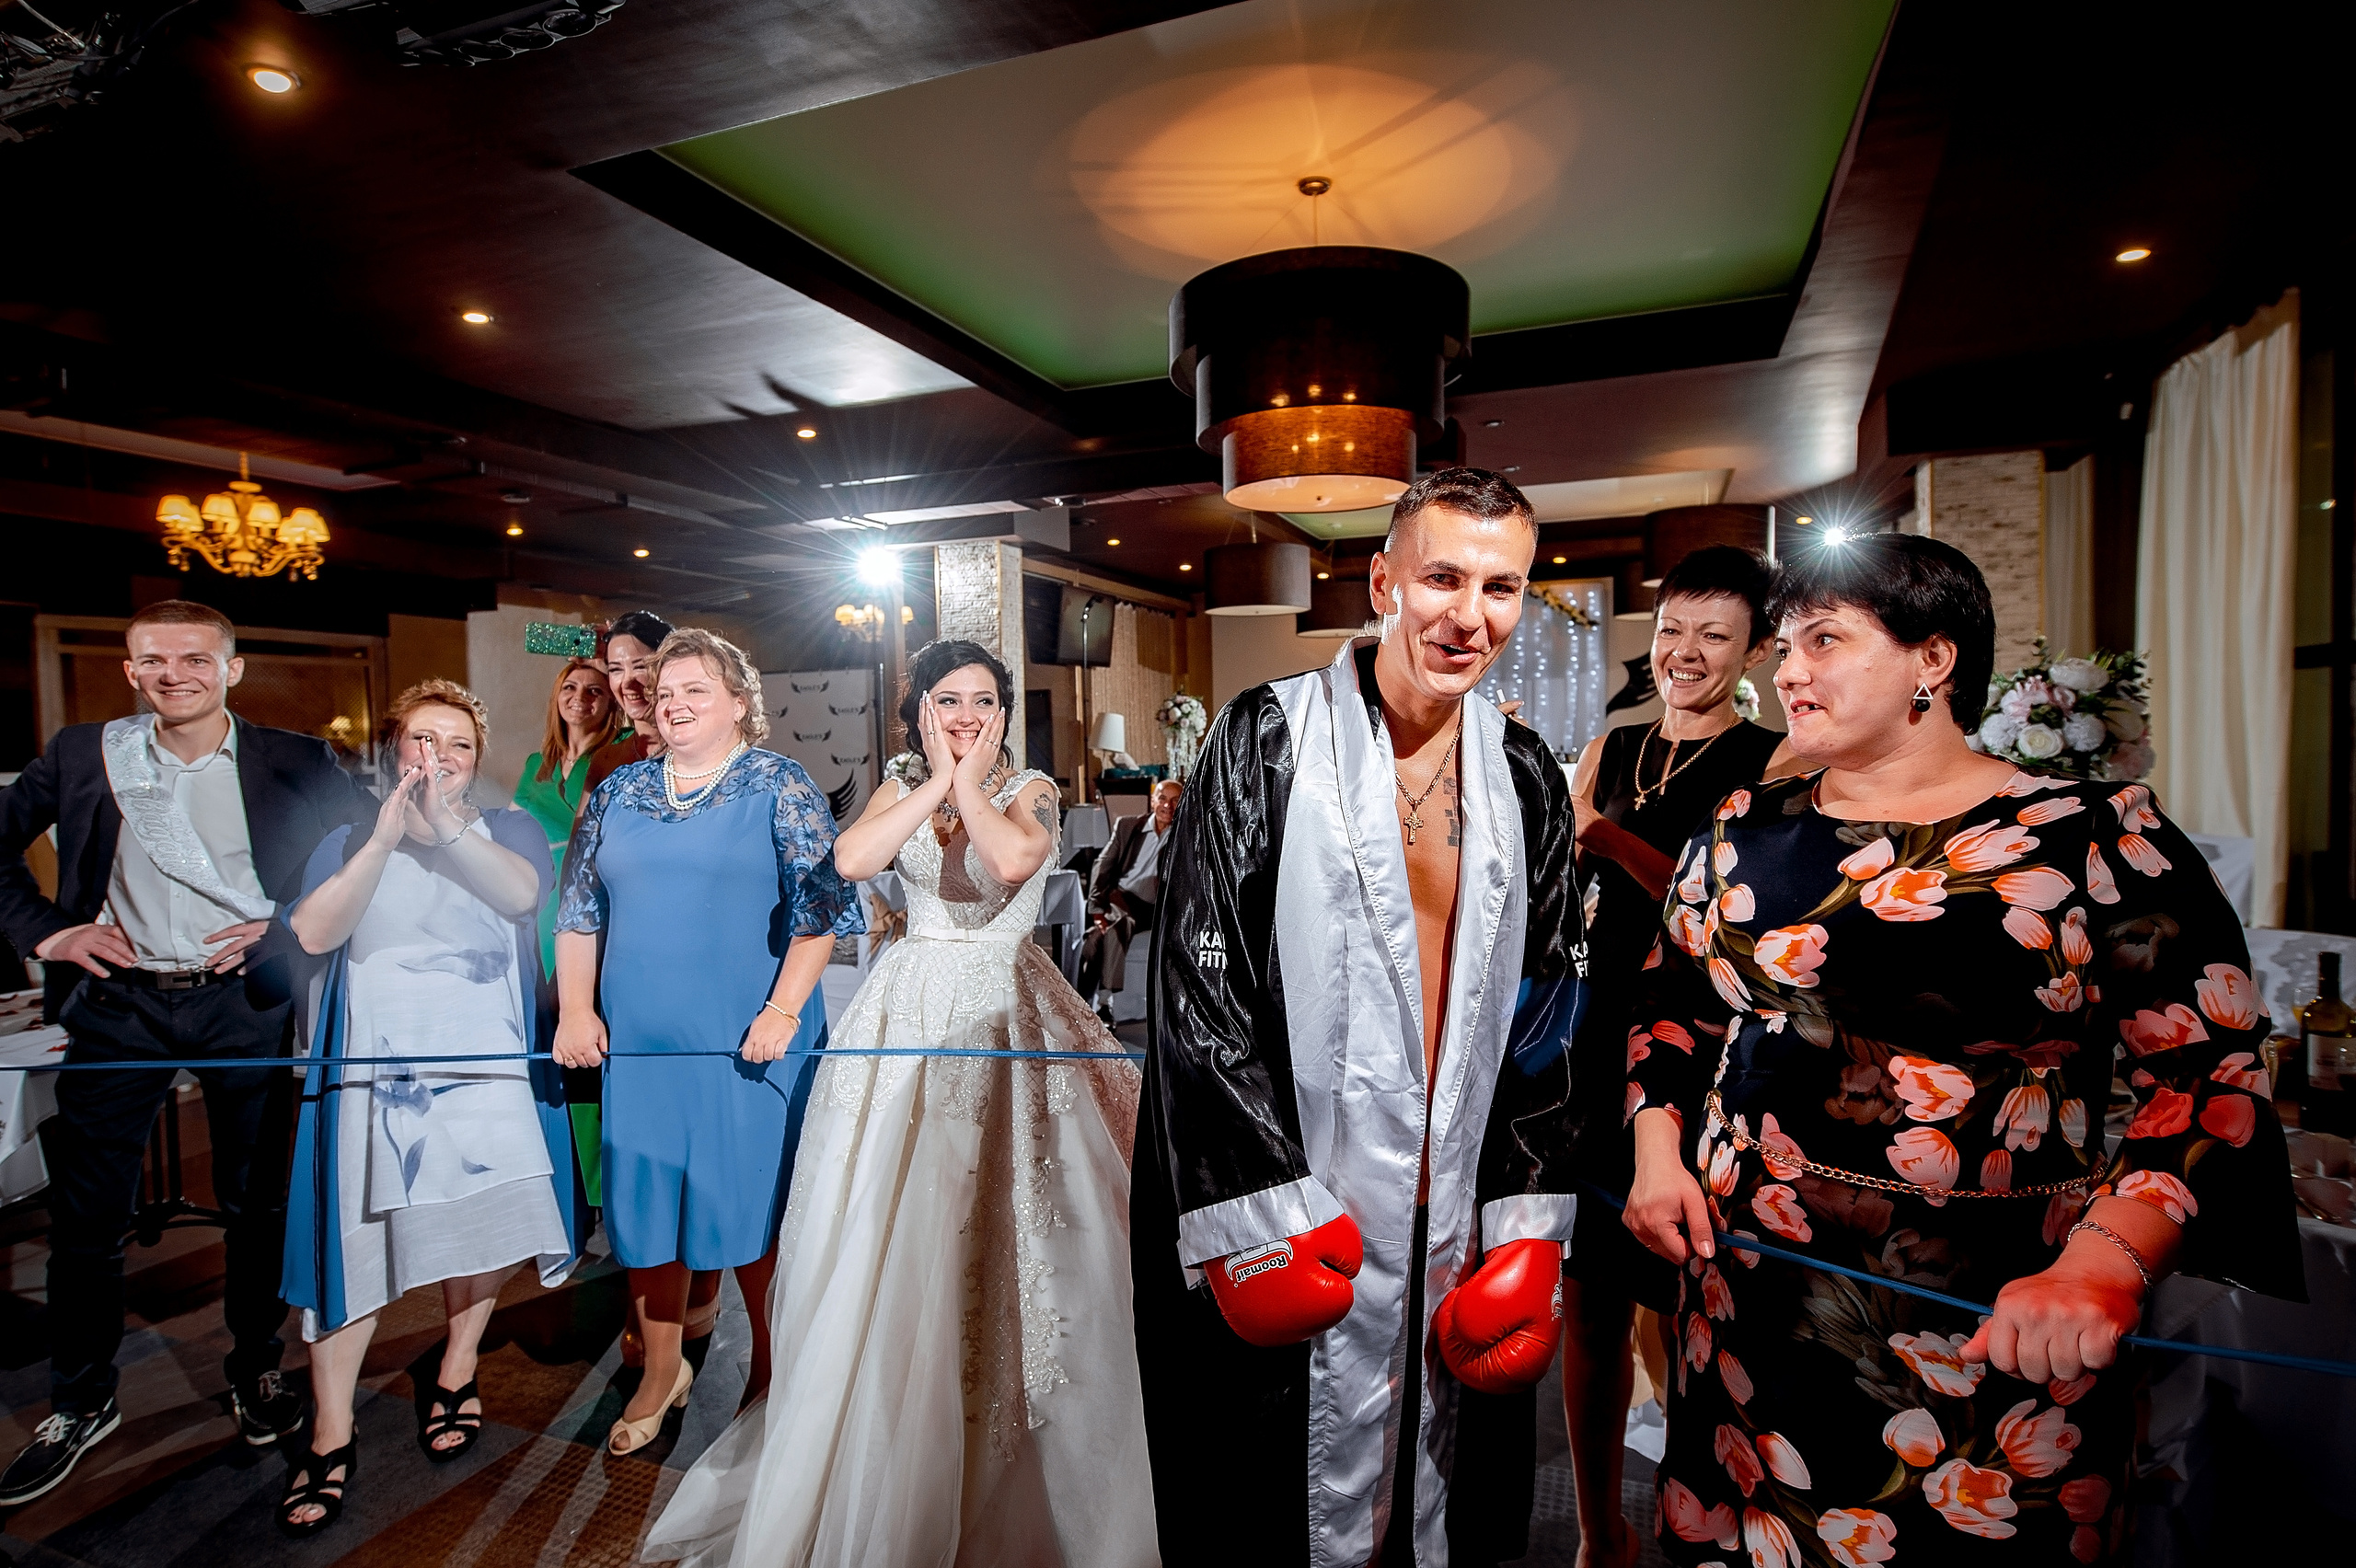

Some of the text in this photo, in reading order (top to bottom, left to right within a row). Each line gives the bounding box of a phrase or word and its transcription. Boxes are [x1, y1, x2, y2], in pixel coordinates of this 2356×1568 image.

[1199, 930, 1226, 950] KA
[1575, 960, 1588, 978] FI
[1235, 1254, 1288, 1283] Roomaif
